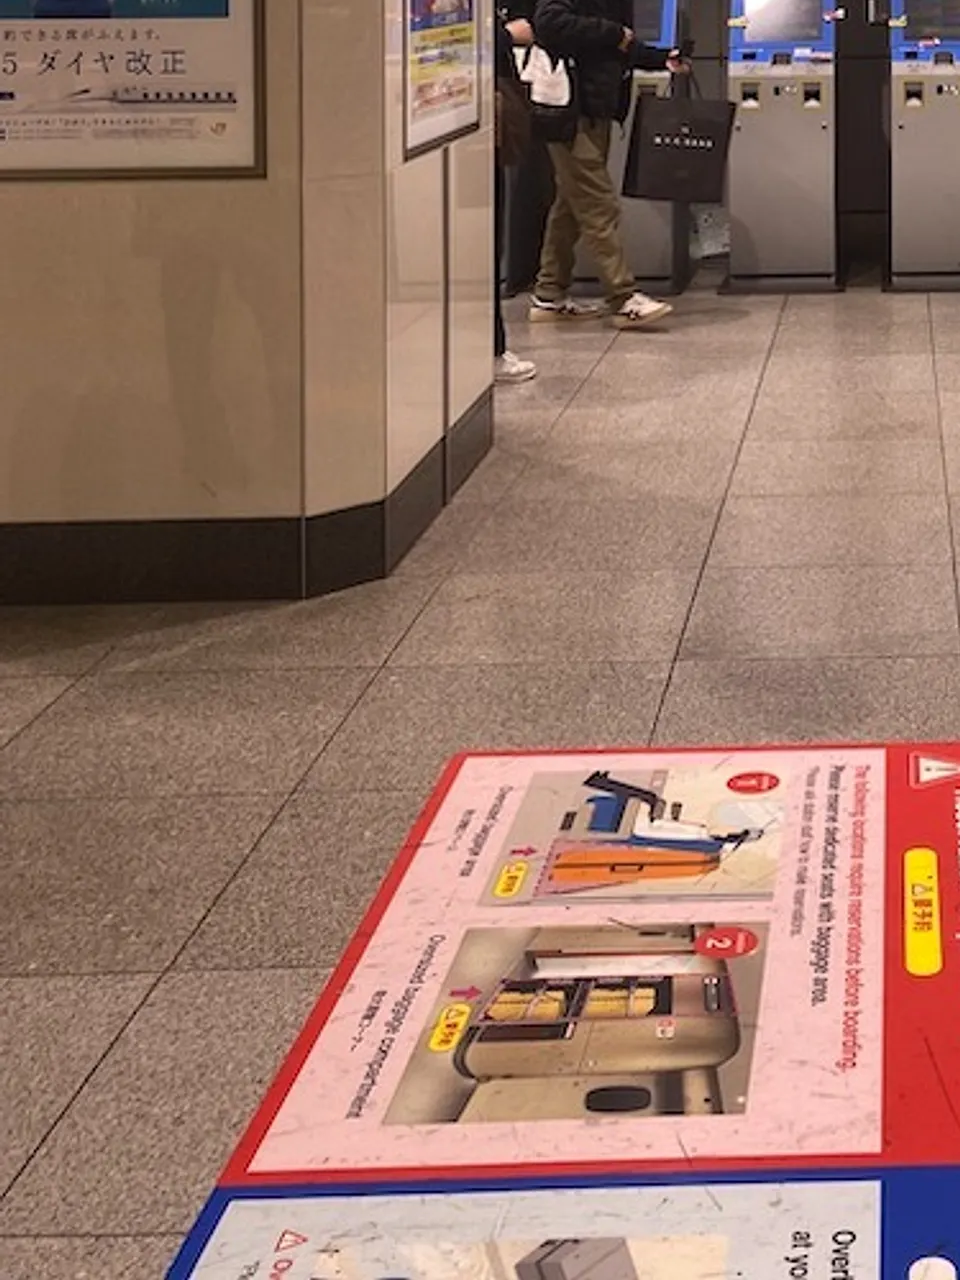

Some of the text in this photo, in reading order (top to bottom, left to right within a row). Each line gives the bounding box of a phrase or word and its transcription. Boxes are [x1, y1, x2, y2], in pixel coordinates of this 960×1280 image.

[821, 826, 841, 870] dedicated
[819, 872, 836, 900] seats
[705, 937, 732, 949] 2
[809, 926, 834, 974] baggage
[845, 898, 864, 966] reservations
[811, 976, 829, 1007] area.
[843, 967, 865, 1008] before
[345, 934, 447, 1120] Oversized baggage compartment
[834, 1009, 863, 1073] boarding.
[791, 1230, 811, 1249] at
